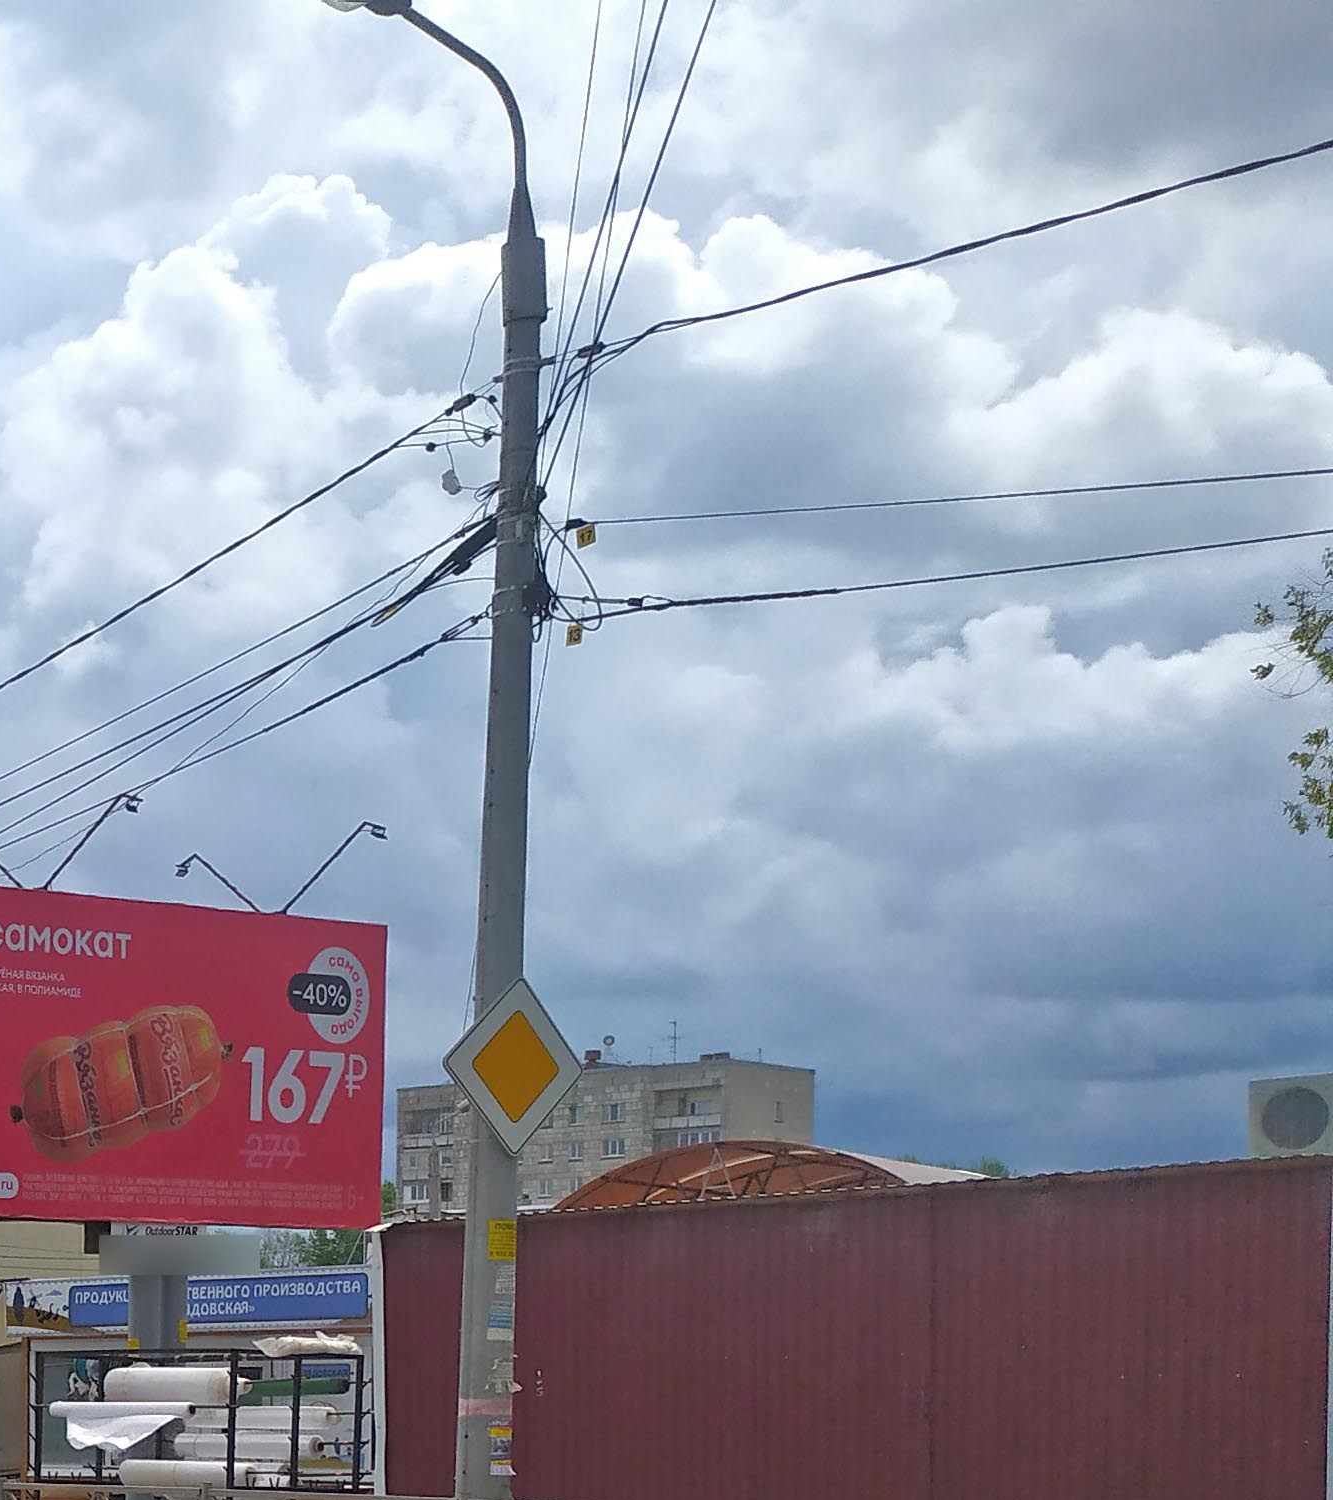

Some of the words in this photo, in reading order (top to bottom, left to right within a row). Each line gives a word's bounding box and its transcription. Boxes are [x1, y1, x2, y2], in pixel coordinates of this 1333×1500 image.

[26, 970, 65, 982] ВЯЗАНКА
[329, 956, 360, 982] сама
[17, 984, 23, 994] В
[25, 984, 82, 998] ПОЛИАМИДЕ
[292, 983, 347, 1008] -40%
[254, 1280, 361, 1297] ПРОИЗВОДСТВА
